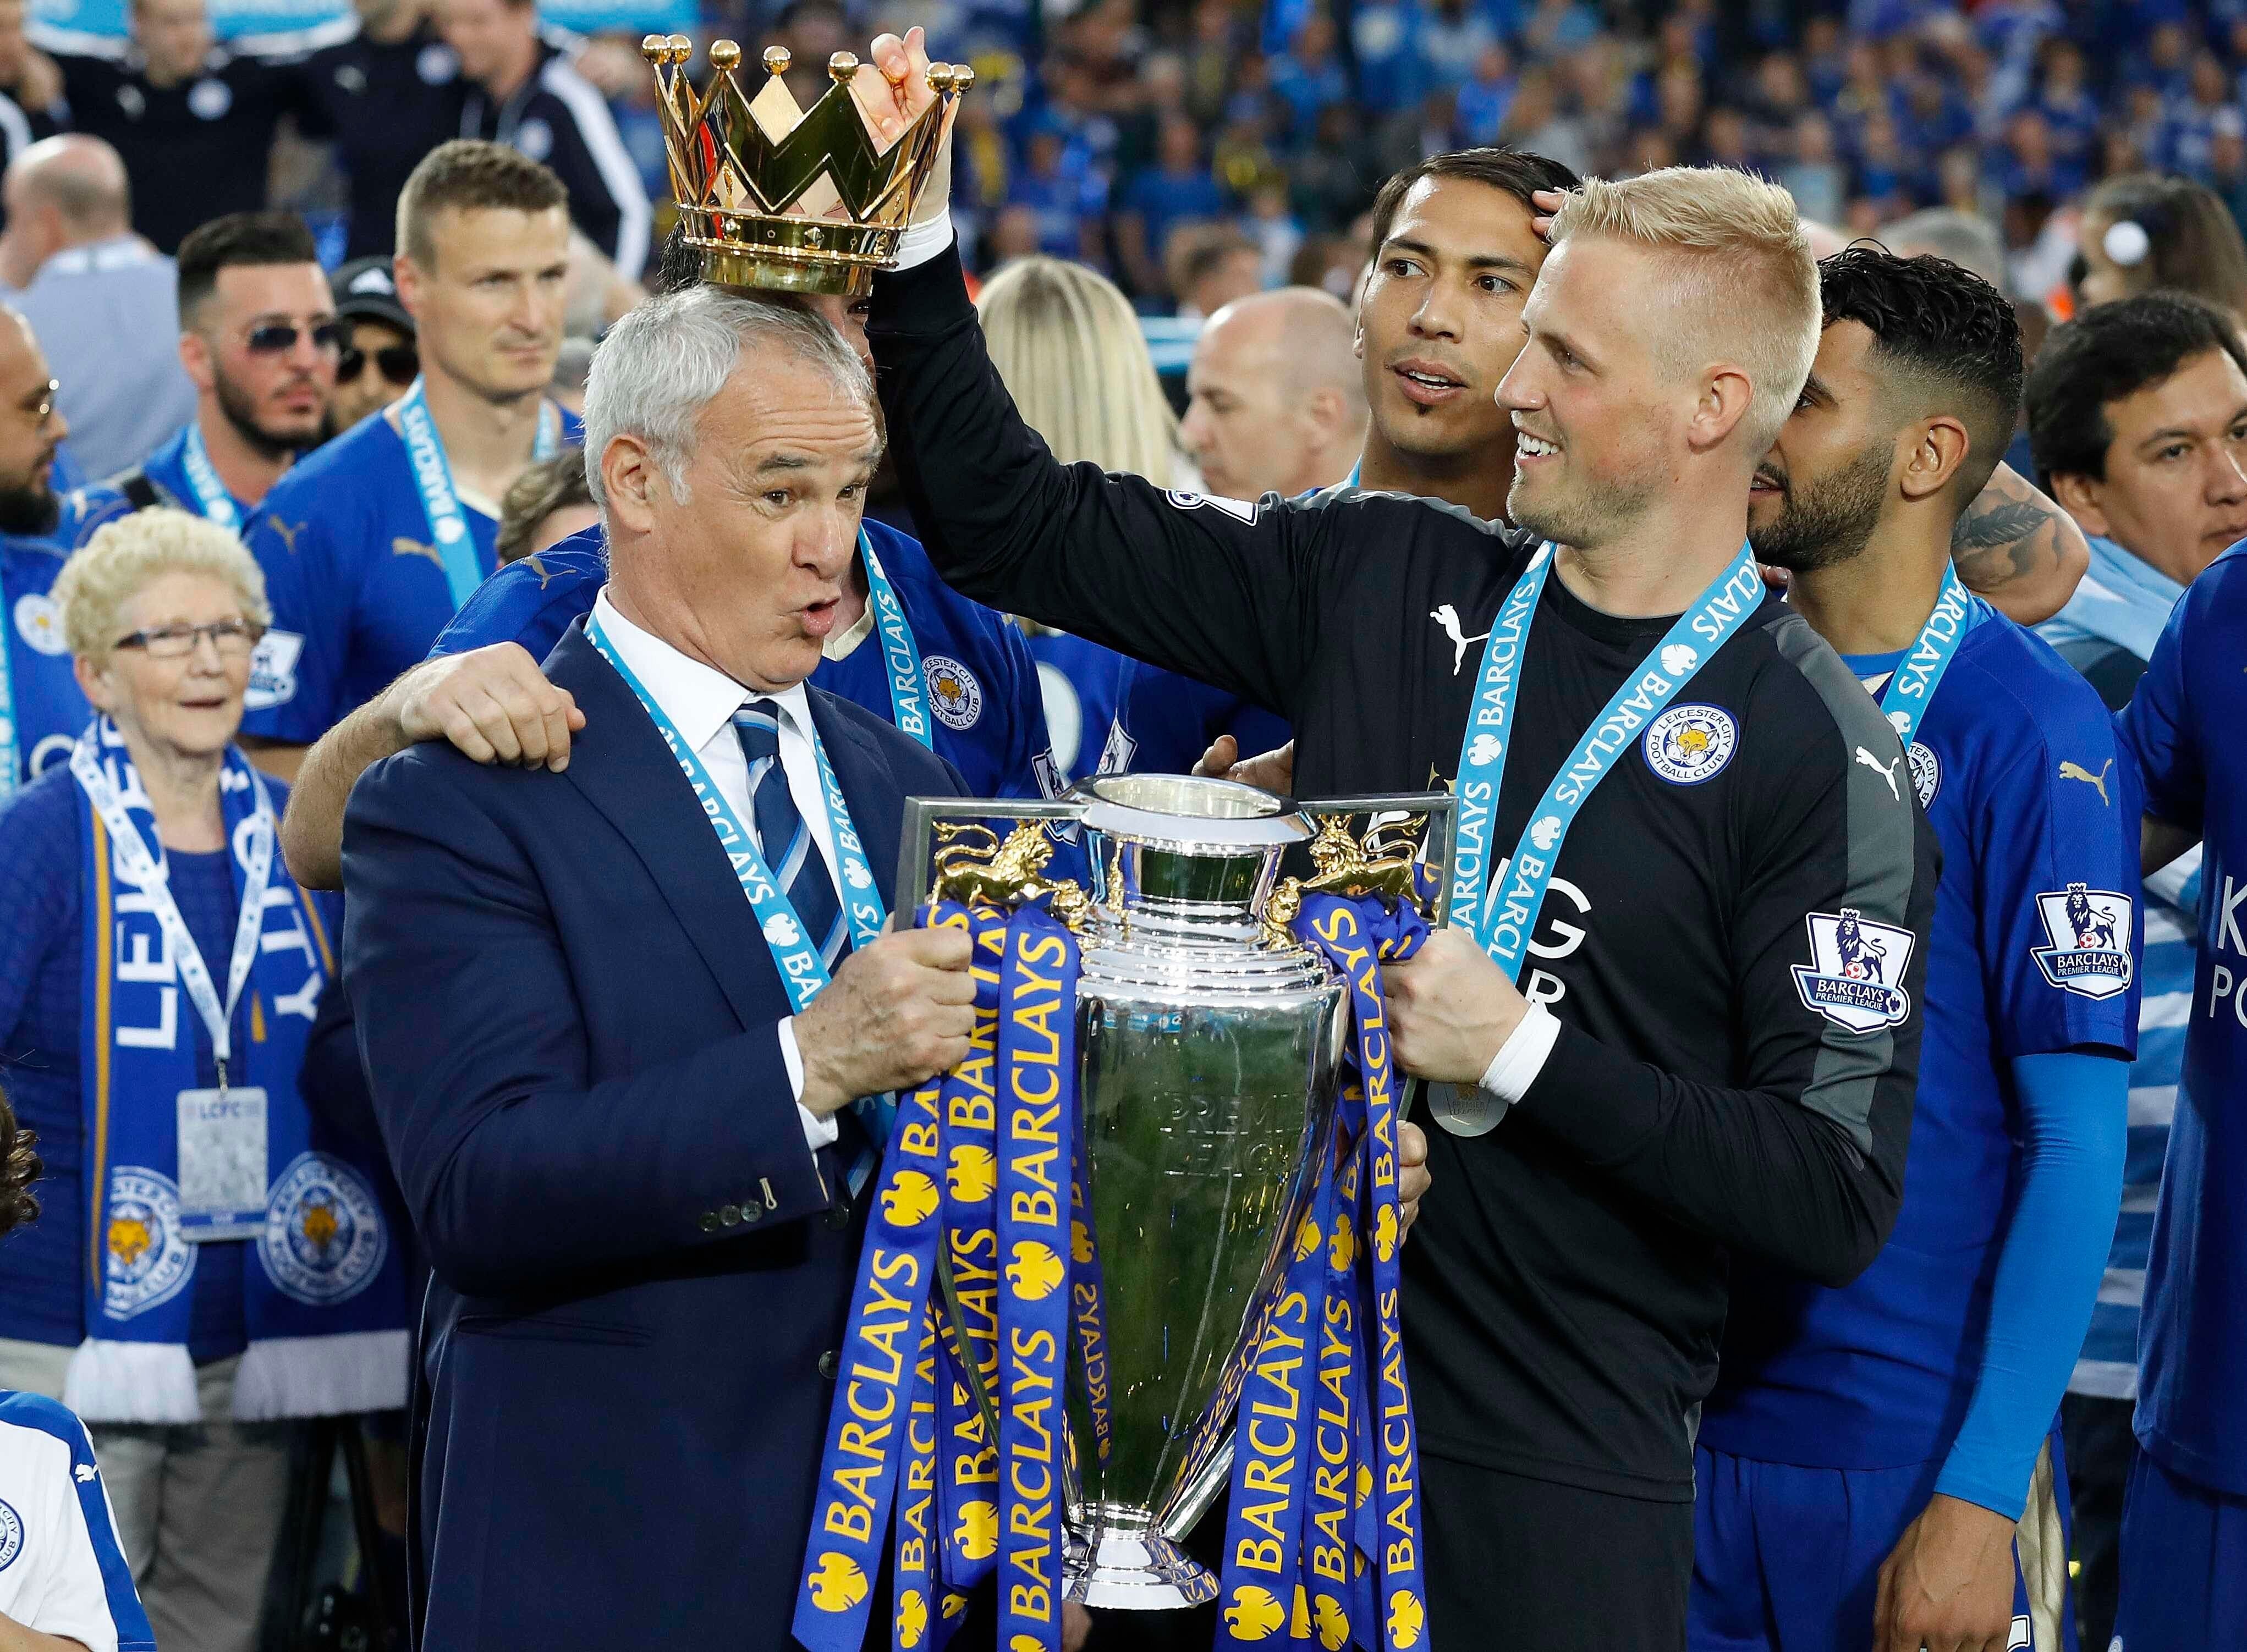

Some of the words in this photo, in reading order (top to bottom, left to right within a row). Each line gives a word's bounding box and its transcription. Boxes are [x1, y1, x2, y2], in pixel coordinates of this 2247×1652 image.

[881, 591, 924, 736] BARCLAYS
[924, 659, 957, 681] EICESTER
[959, 669, 977, 692] CITY
[1476, 579, 1536, 727] BARCLAYS
[927, 691, 967, 726] OOTBALL
[966, 697, 979, 723] CLUB
[1658, 709, 1724, 730] LEICESTER
[1721, 723, 1732, 748] CITY
[1556, 671, 1672, 807] BARCLAYS
[1650, 734, 1691, 779] FOOTBALL
[1694, 753, 1724, 777] CLUB
[1926, 760, 1935, 786] CITY
[2057, 966, 2090, 976] PREMIER
[2092, 965, 2119, 975] LEAGUE
[2058, 952, 2119, 968] BARCLAYS
[1815, 992, 1853, 1004] PREMIER
[1855, 996, 1882, 1011] LEAGUE
[1817, 979, 1885, 1003] BARCLAYS
[1311, 906, 1394, 1188] BARCLAYS
[1011, 932, 1066, 1227] BARCLAYS
[824, 1248, 919, 1544] BARCLAYS
[1235, 1291, 1307, 1574] BARCLAYS
[1313, 1295, 1352, 1585] BARCLAYS
[1380, 1287, 1415, 1575] BARCLAYS
[1010, 1327, 1057, 1622] BARCLAYS
[2, 1510, 18, 1534] CITY
[0, 1540, 16, 1562] LUB
